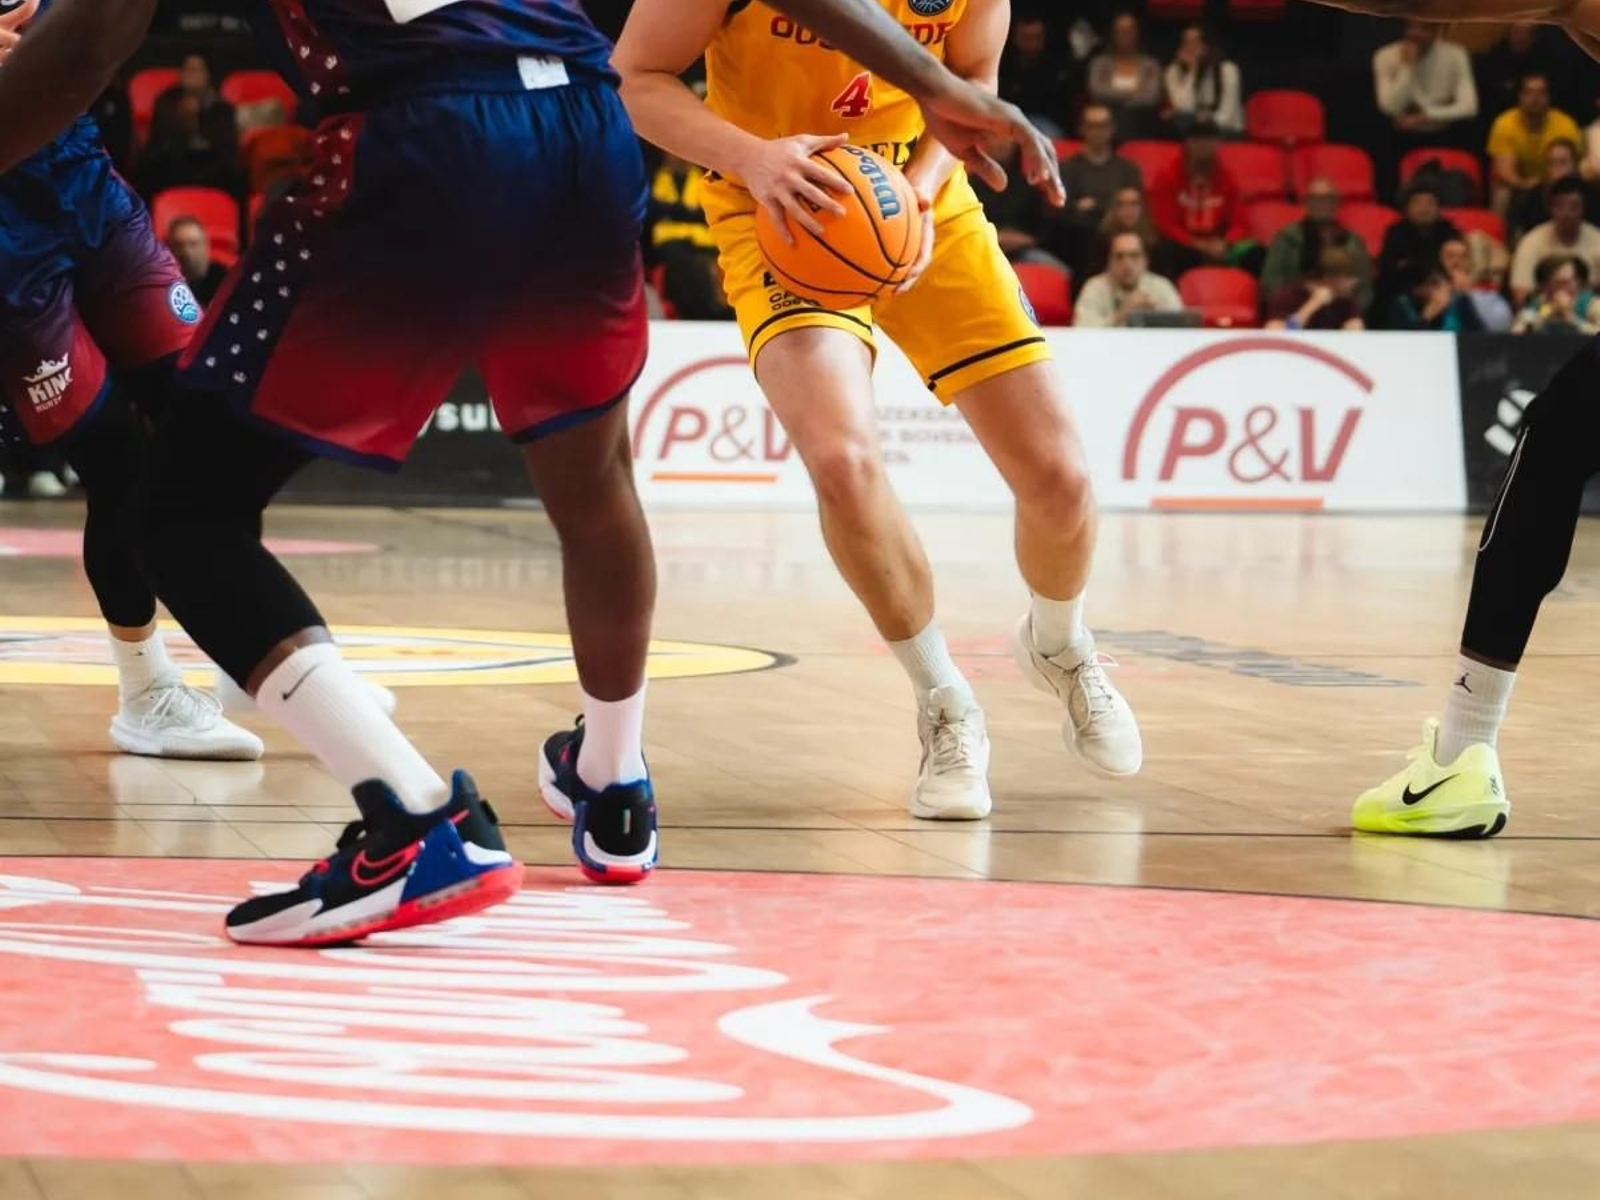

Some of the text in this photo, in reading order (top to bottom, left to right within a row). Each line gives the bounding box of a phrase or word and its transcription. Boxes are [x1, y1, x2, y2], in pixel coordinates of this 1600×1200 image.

[830, 70, 872, 120] 4
[840, 145, 902, 221] Wilso
[658, 404, 793, 464] P&V
[1157, 404, 1364, 484] P&V
